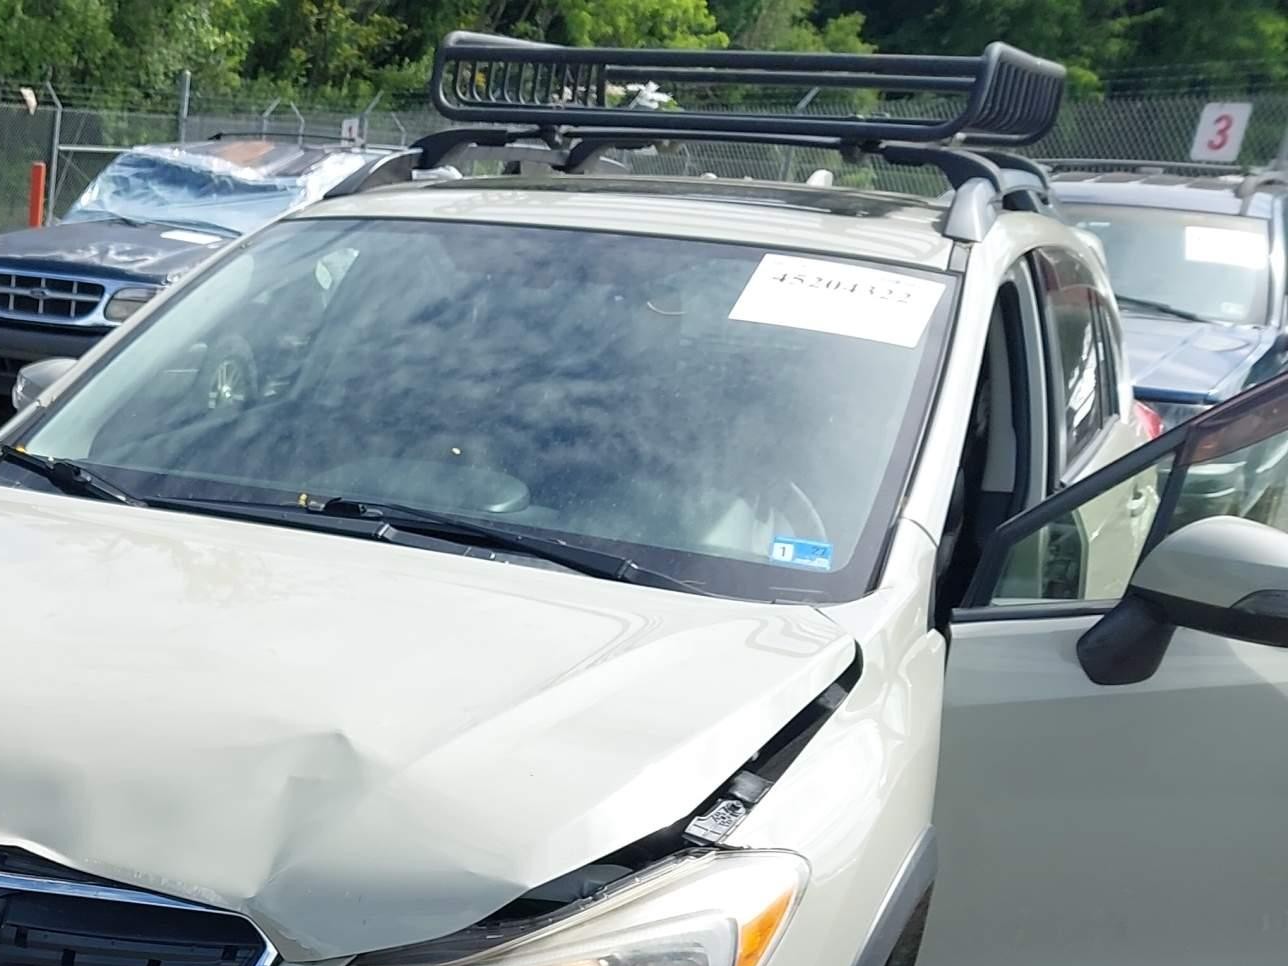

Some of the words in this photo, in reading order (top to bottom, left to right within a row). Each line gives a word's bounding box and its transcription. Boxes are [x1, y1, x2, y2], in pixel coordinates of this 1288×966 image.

[1207, 114, 1233, 151] 3
[772, 273, 912, 304] 45204322
[779, 545, 786, 557] 1
